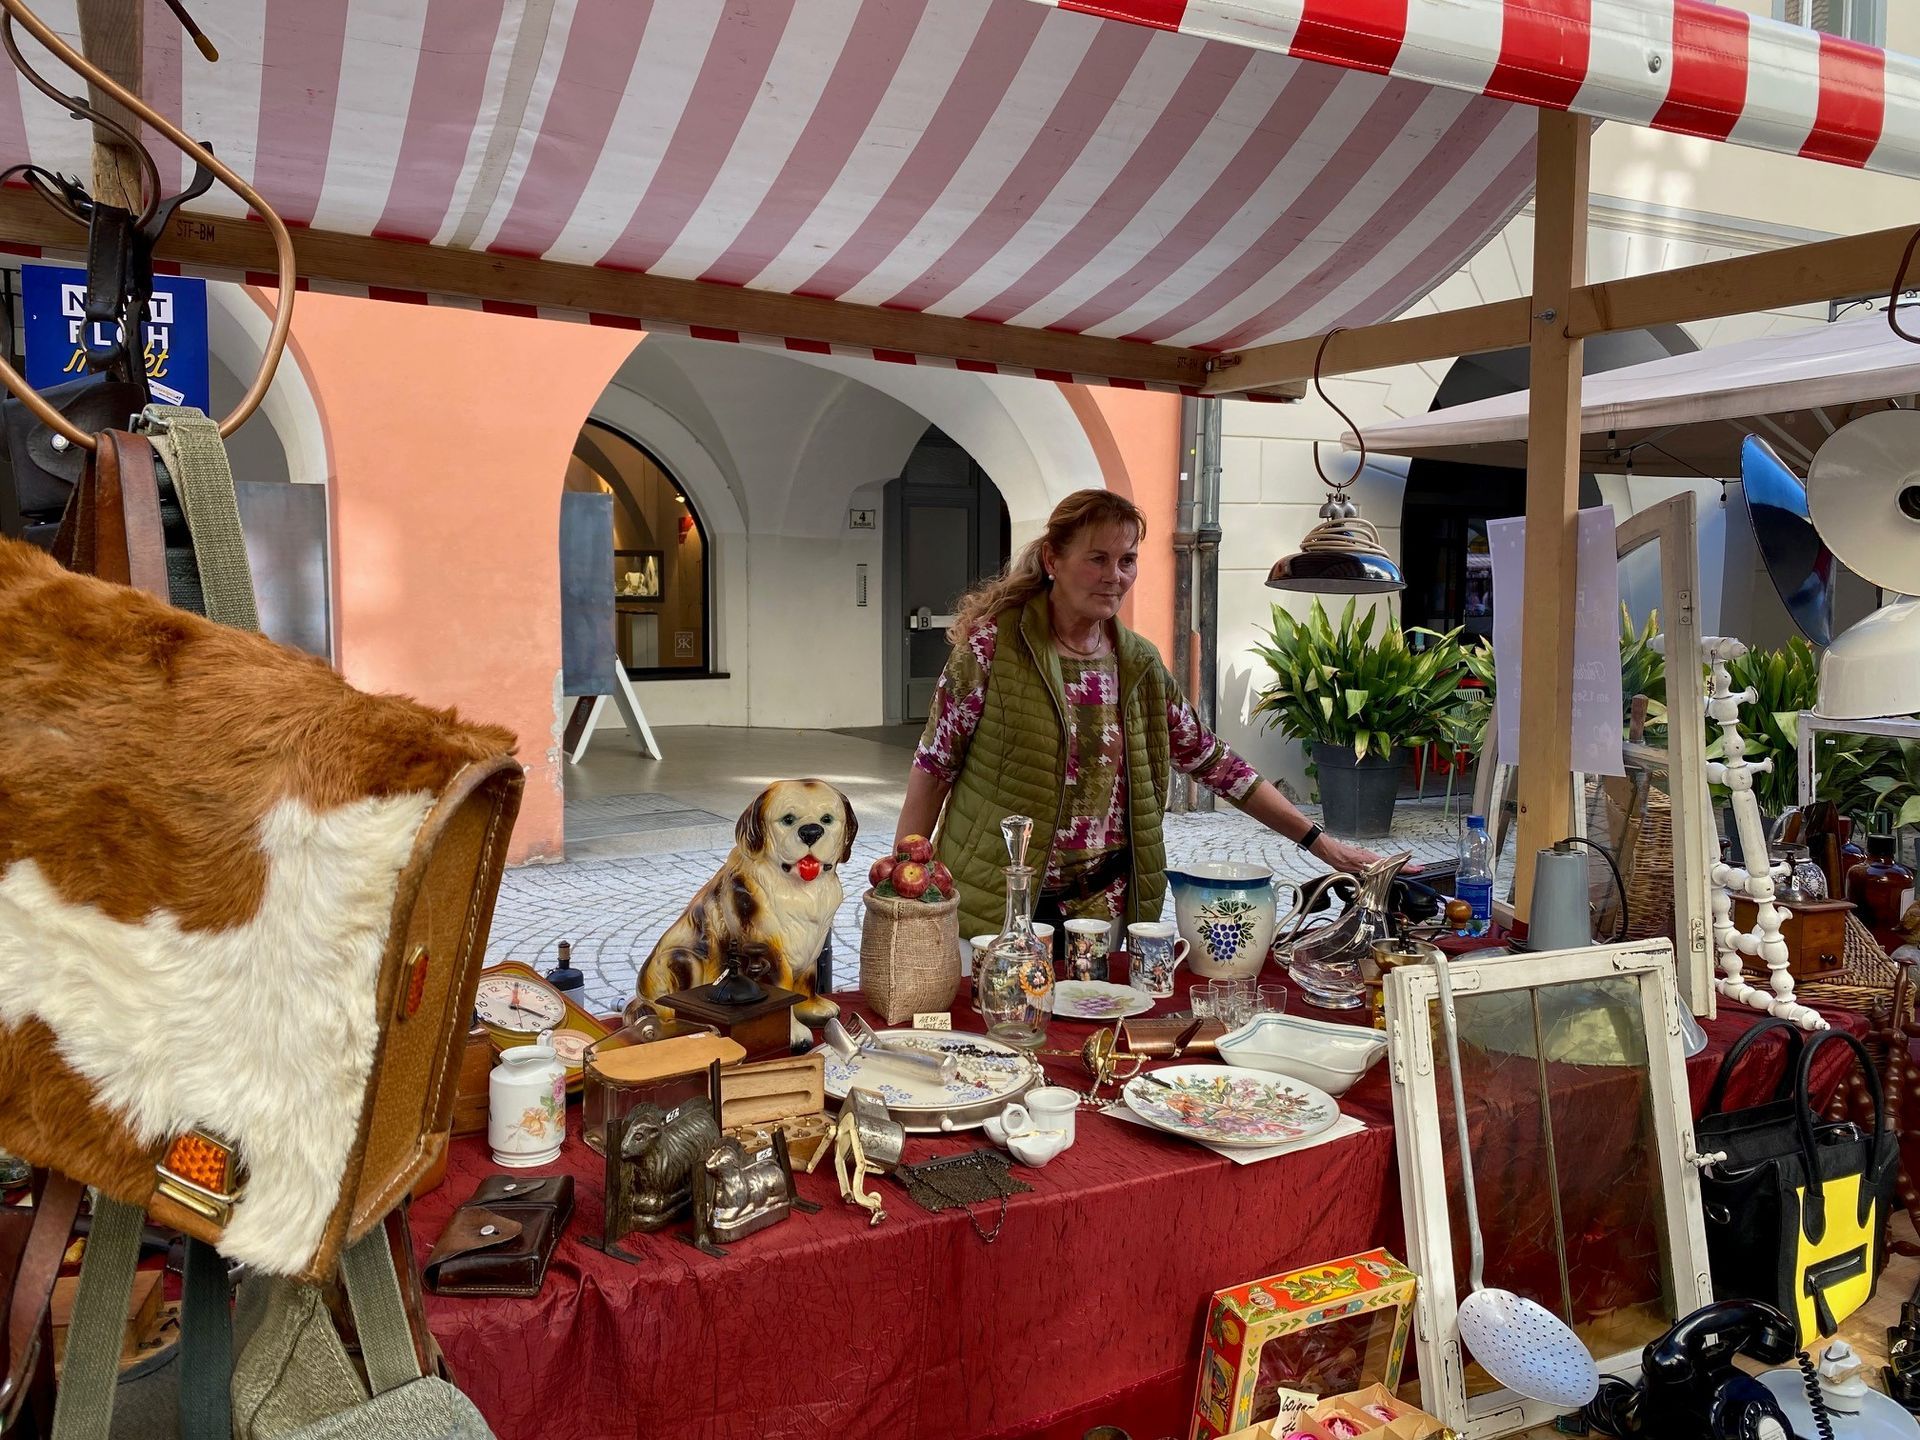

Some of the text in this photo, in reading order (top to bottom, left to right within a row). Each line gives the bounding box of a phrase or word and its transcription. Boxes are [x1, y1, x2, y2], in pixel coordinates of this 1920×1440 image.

[176, 219, 215, 242] STF-BM
[69, 320, 168, 350] FLH
[859, 511, 866, 521] 4
[921, 616, 929, 628] B
